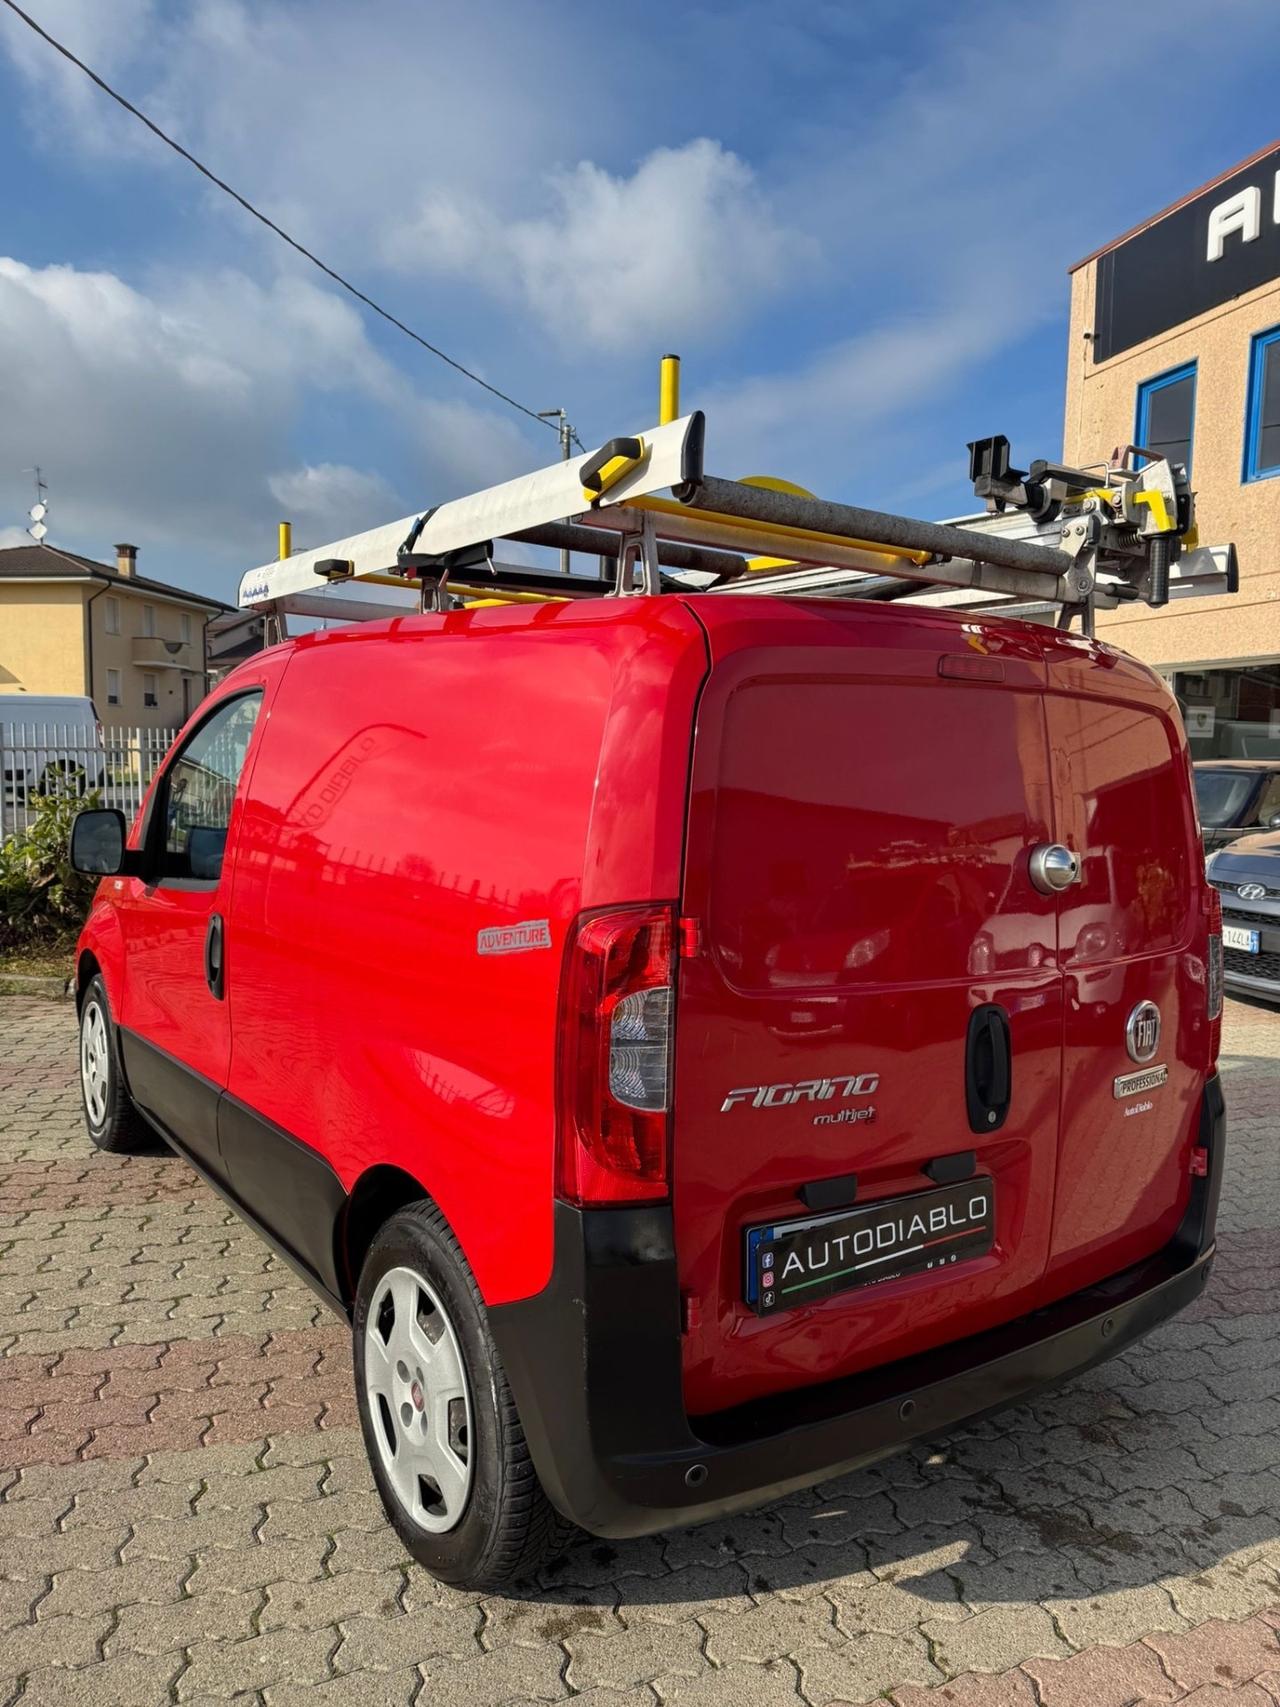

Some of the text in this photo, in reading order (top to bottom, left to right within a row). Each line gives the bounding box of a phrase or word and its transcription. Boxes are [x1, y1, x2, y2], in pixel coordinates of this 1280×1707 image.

[1206, 169, 1280, 262] A
[480, 927, 547, 948] ADVENTURE
[1137, 1019, 1157, 1048] FIAT
[720, 1072, 880, 1112] FIORINO
[1121, 1071, 1167, 1094] PROFESSIONAL
[813, 1105, 876, 1125] multijet
[781, 1195, 987, 1279] AUTODIABLO
